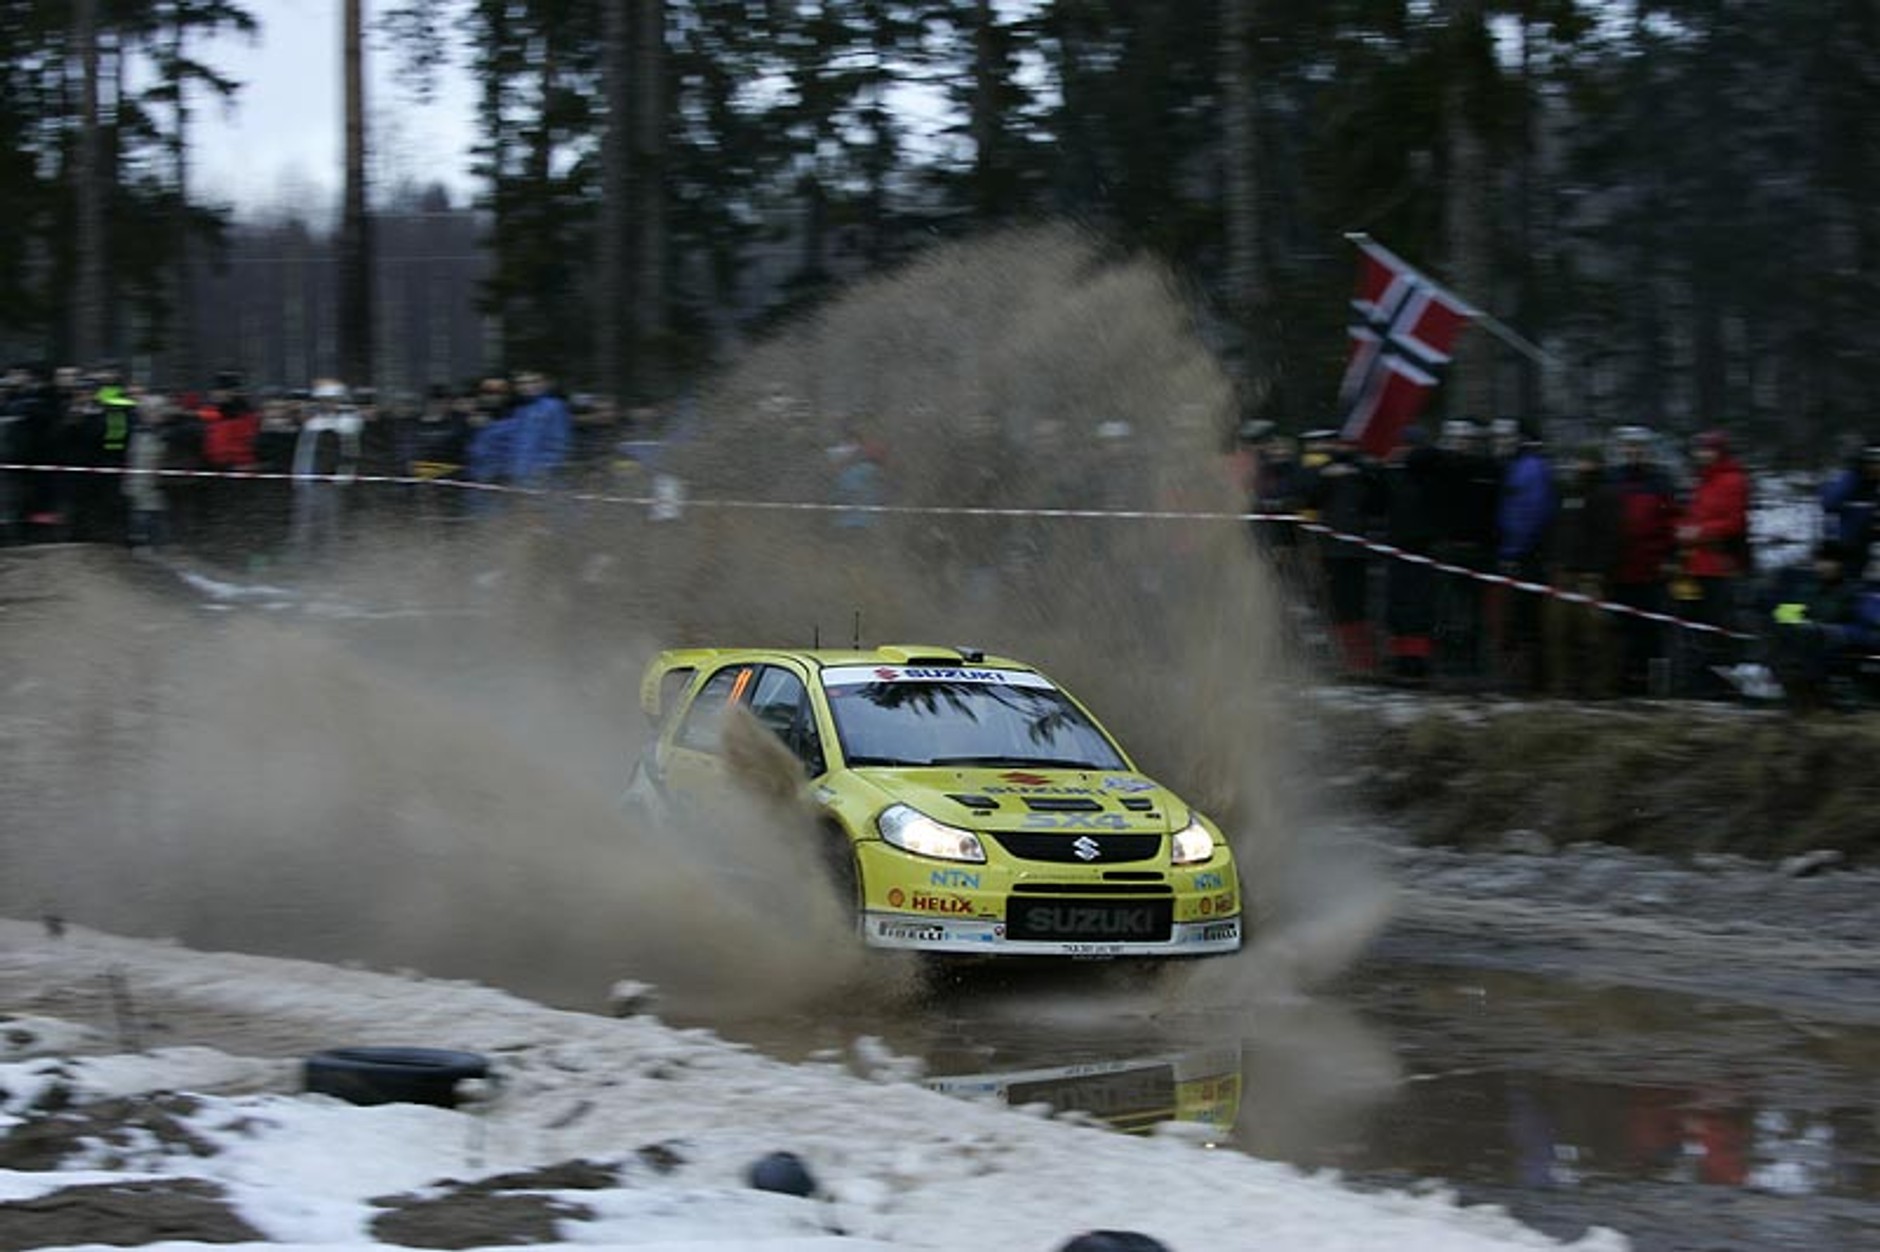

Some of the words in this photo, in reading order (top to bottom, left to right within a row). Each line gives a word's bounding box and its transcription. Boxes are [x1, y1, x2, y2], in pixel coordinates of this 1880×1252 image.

[904, 669, 1005, 681] SUZUKI
[1023, 812, 1132, 830] SX4
[930, 870, 979, 889] NTN
[912, 896, 973, 913] HELIX
[1026, 907, 1153, 933] SUZUKI
